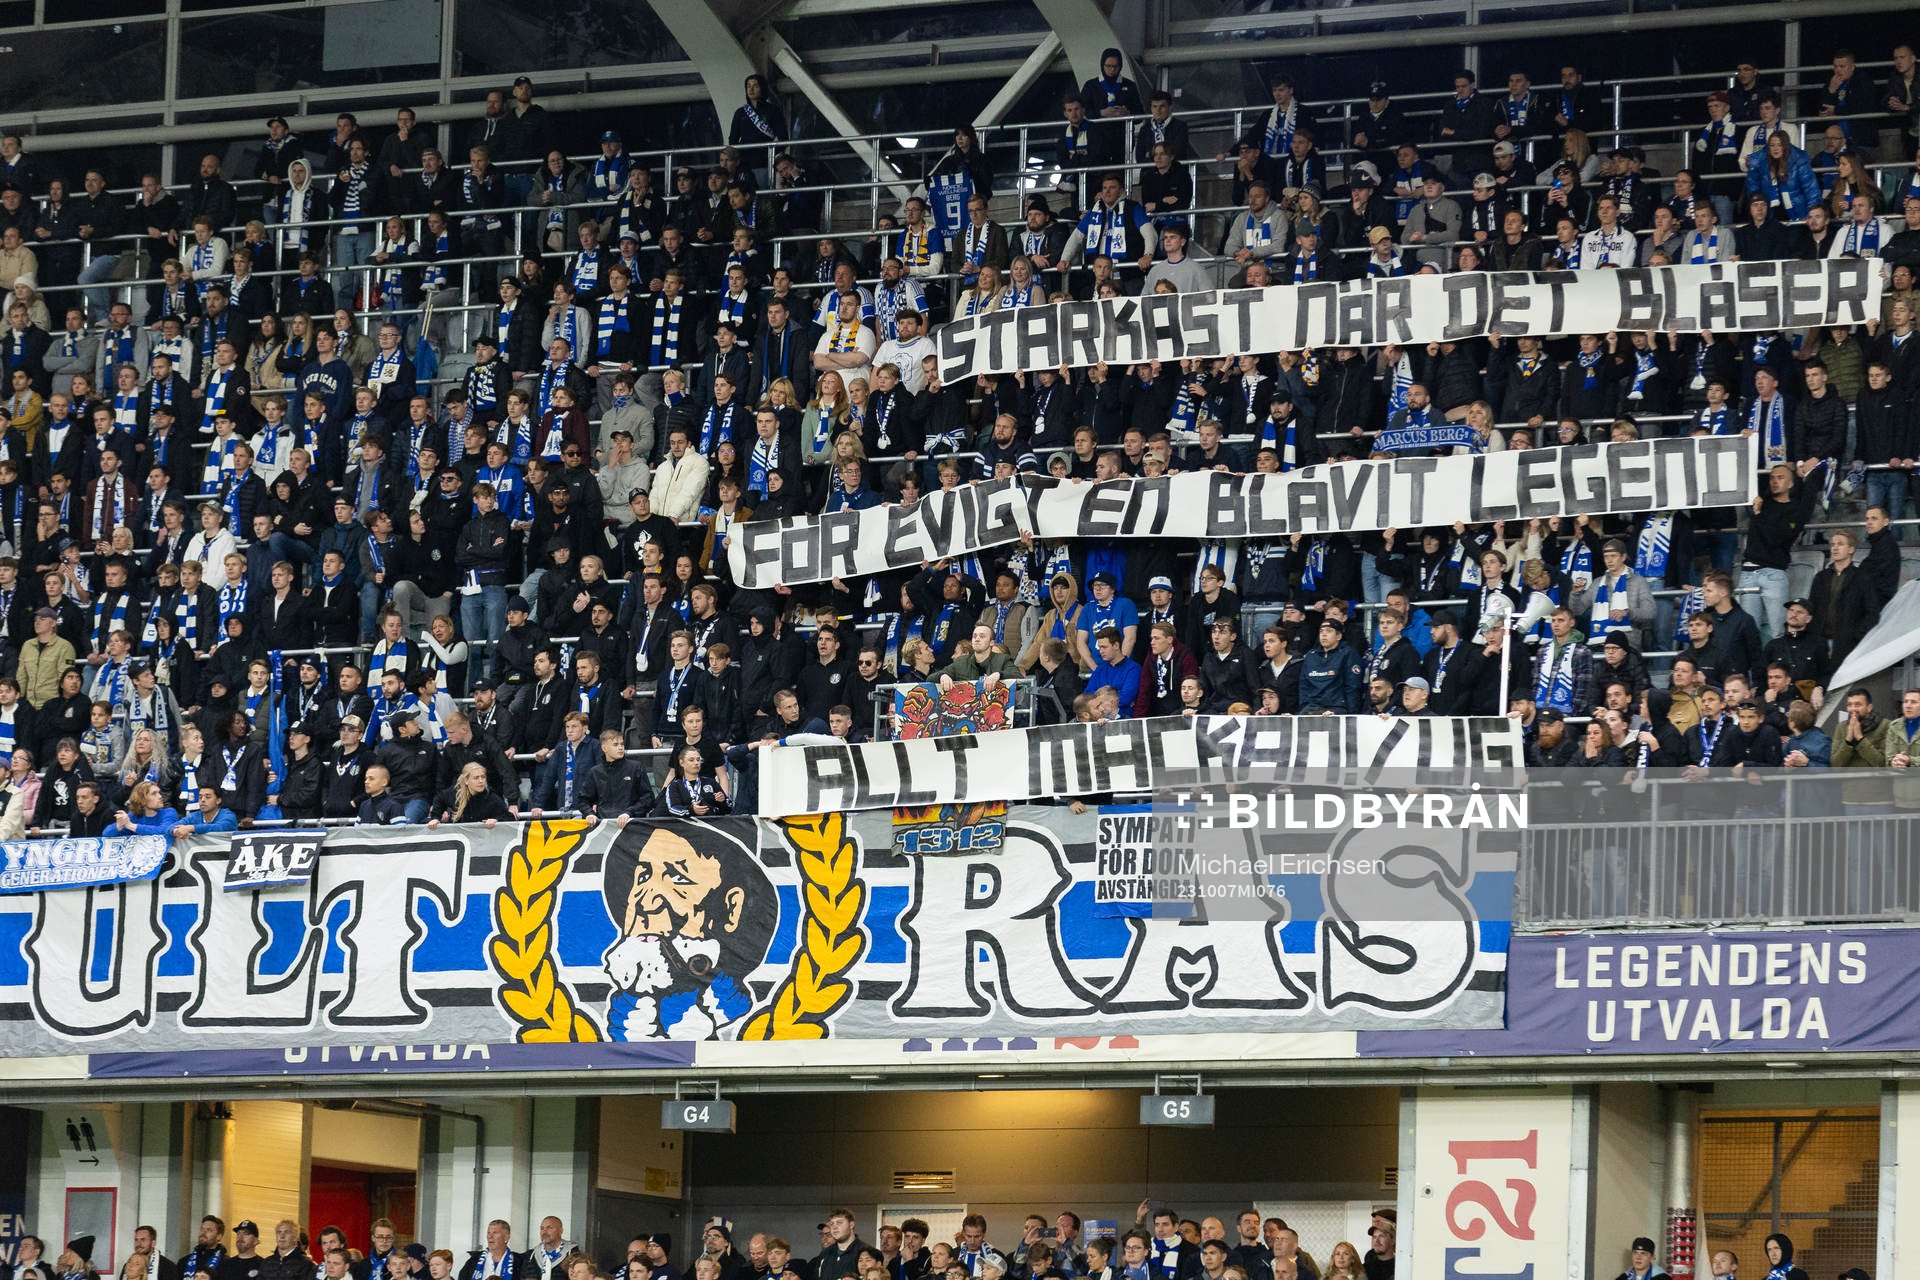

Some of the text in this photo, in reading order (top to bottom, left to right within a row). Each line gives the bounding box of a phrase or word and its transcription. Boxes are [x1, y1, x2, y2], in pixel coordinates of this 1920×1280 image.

[946, 201, 961, 230] 9
[942, 258, 1869, 383] STARKAST NÄR DET BLÅSER
[1376, 430, 1428, 449] MARCUS
[1430, 428, 1465, 441] BERG
[742, 437, 1750, 587] FÖR EVIGT EN BLÅVIT LEGEND
[804, 735, 978, 812] ALLT
[897, 823, 1002, 854] 1312
[1099, 816, 1195, 844] SYMPATI
[2, 837, 127, 870] YNGRE
[229, 838, 317, 875] ÅKE
[1098, 844, 1195, 875] FÖR DOM
[1, 866, 117, 887] GENERATIONEN
[1097, 875, 1191, 899] AVSTÄNGDA
[1555, 941, 1866, 988] LEGENDENS
[1587, 997, 1829, 1042] UTVALDA
[683, 1105, 710, 1123] G4
[1163, 1100, 1190, 1118] G5
